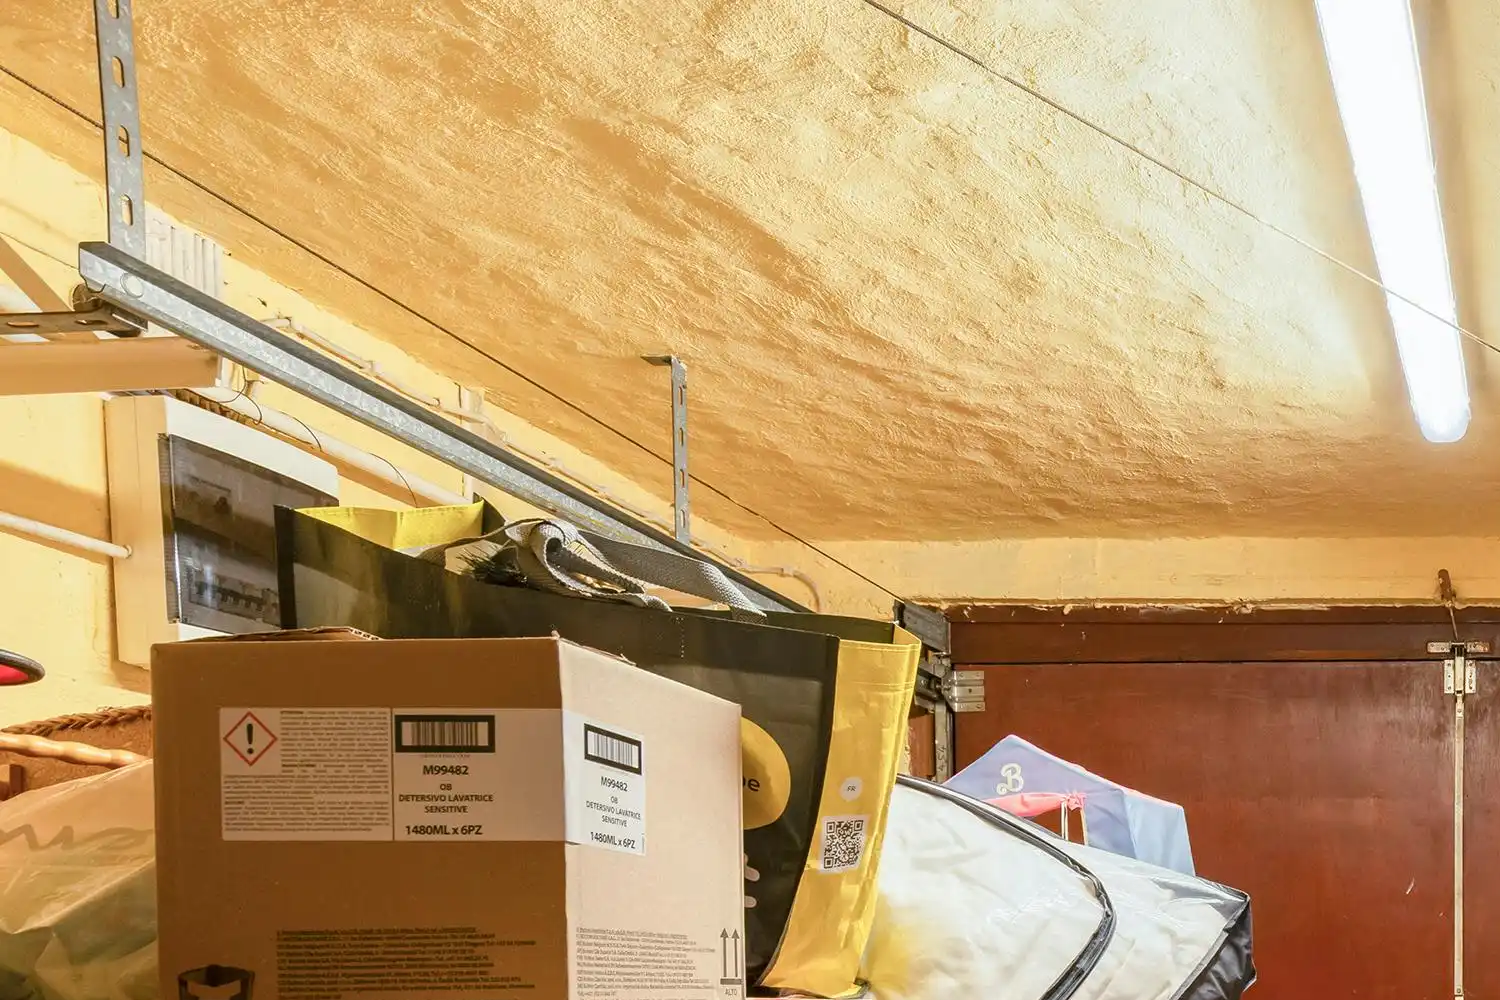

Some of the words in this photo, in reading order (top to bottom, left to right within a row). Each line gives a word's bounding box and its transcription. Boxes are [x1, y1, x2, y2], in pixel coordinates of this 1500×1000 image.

[423, 765, 469, 775] M99482
[600, 776, 628, 792] M99482
[399, 794, 446, 802] DETERSIVO
[448, 794, 493, 802] LAVATRICE
[585, 800, 615, 814] DETERSIVO
[615, 808, 641, 820] LAVATRICE
[602, 815, 627, 827] SENSITIVE
[406, 825, 450, 835] 1480ML
[461, 825, 483, 835] 6PZ
[590, 832, 617, 845] 1480ML
[623, 838, 635, 849] 6PZ
